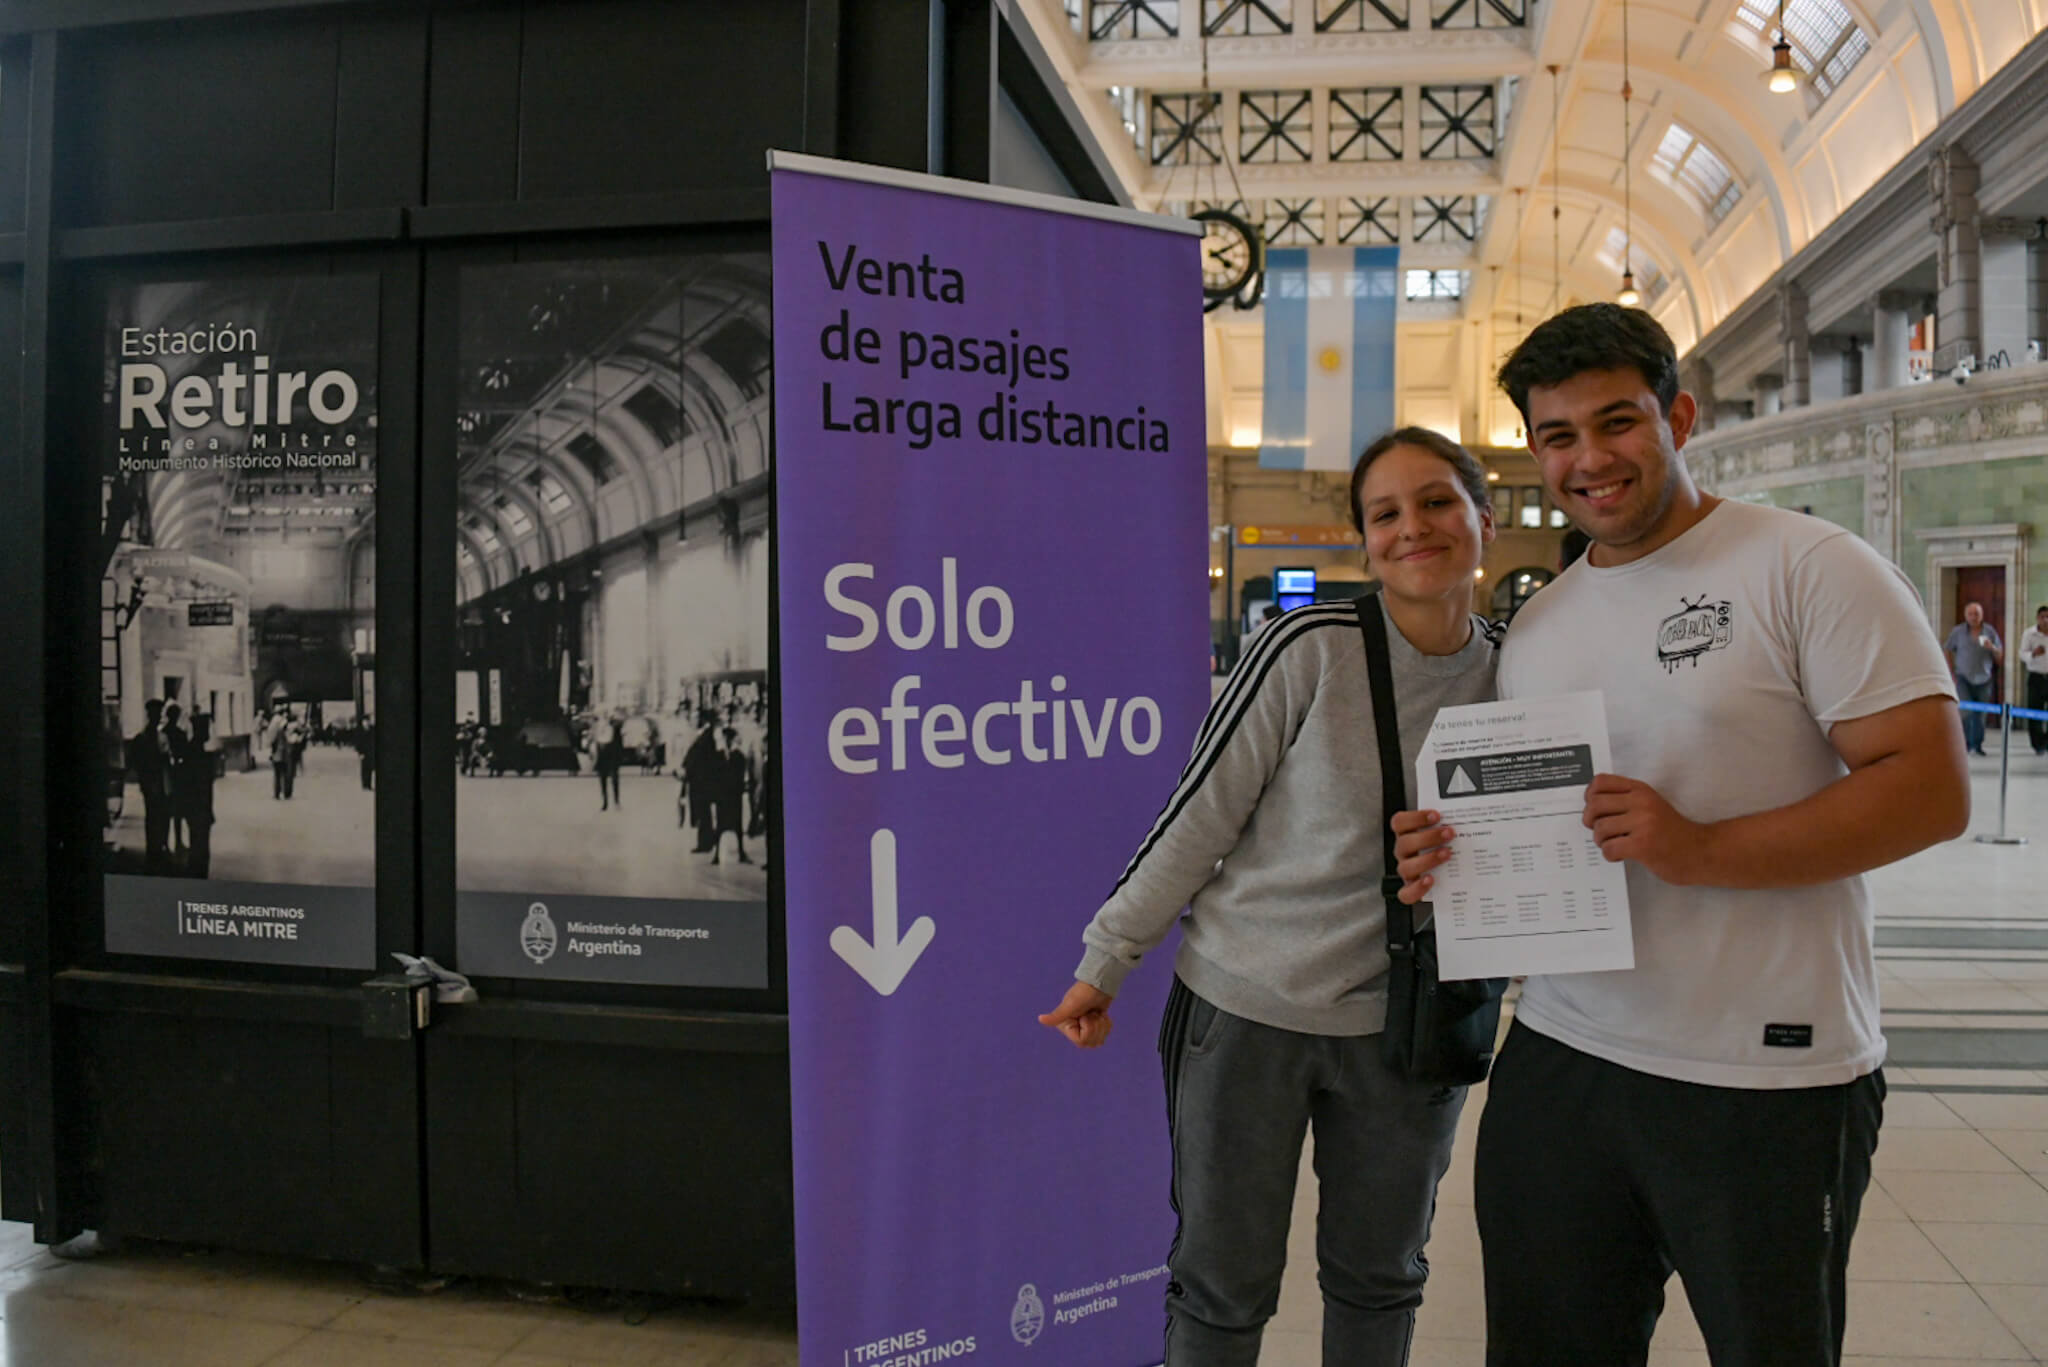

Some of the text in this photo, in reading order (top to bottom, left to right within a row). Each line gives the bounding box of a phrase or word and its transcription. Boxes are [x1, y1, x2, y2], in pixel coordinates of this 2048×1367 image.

[818, 241, 964, 304] Venta
[122, 322, 257, 356] Estación
[820, 309, 1070, 388] de pasajes
[120, 355, 358, 429] Retiro
[823, 382, 1169, 453] Larga distancia
[119, 433, 356, 453] Línea Mitre
[119, 451, 356, 471] Monumento Histórico Nacional
[824, 557, 1014, 652] Solo
[827, 675, 1162, 774] efectivo
[186, 902, 305, 920] TRENES ARGENTINOS
[186, 915, 298, 940] LÍNEA MITRE
[567, 921, 710, 940] Ministerio de Transporte
[567, 938, 642, 957] Argentina
[1053, 1281, 1105, 1305] Ministerio
[1106, 1278, 1119, 1290] de
[1053, 1296, 1118, 1325] Argentina
[854, 1328, 927, 1363] TRENES
